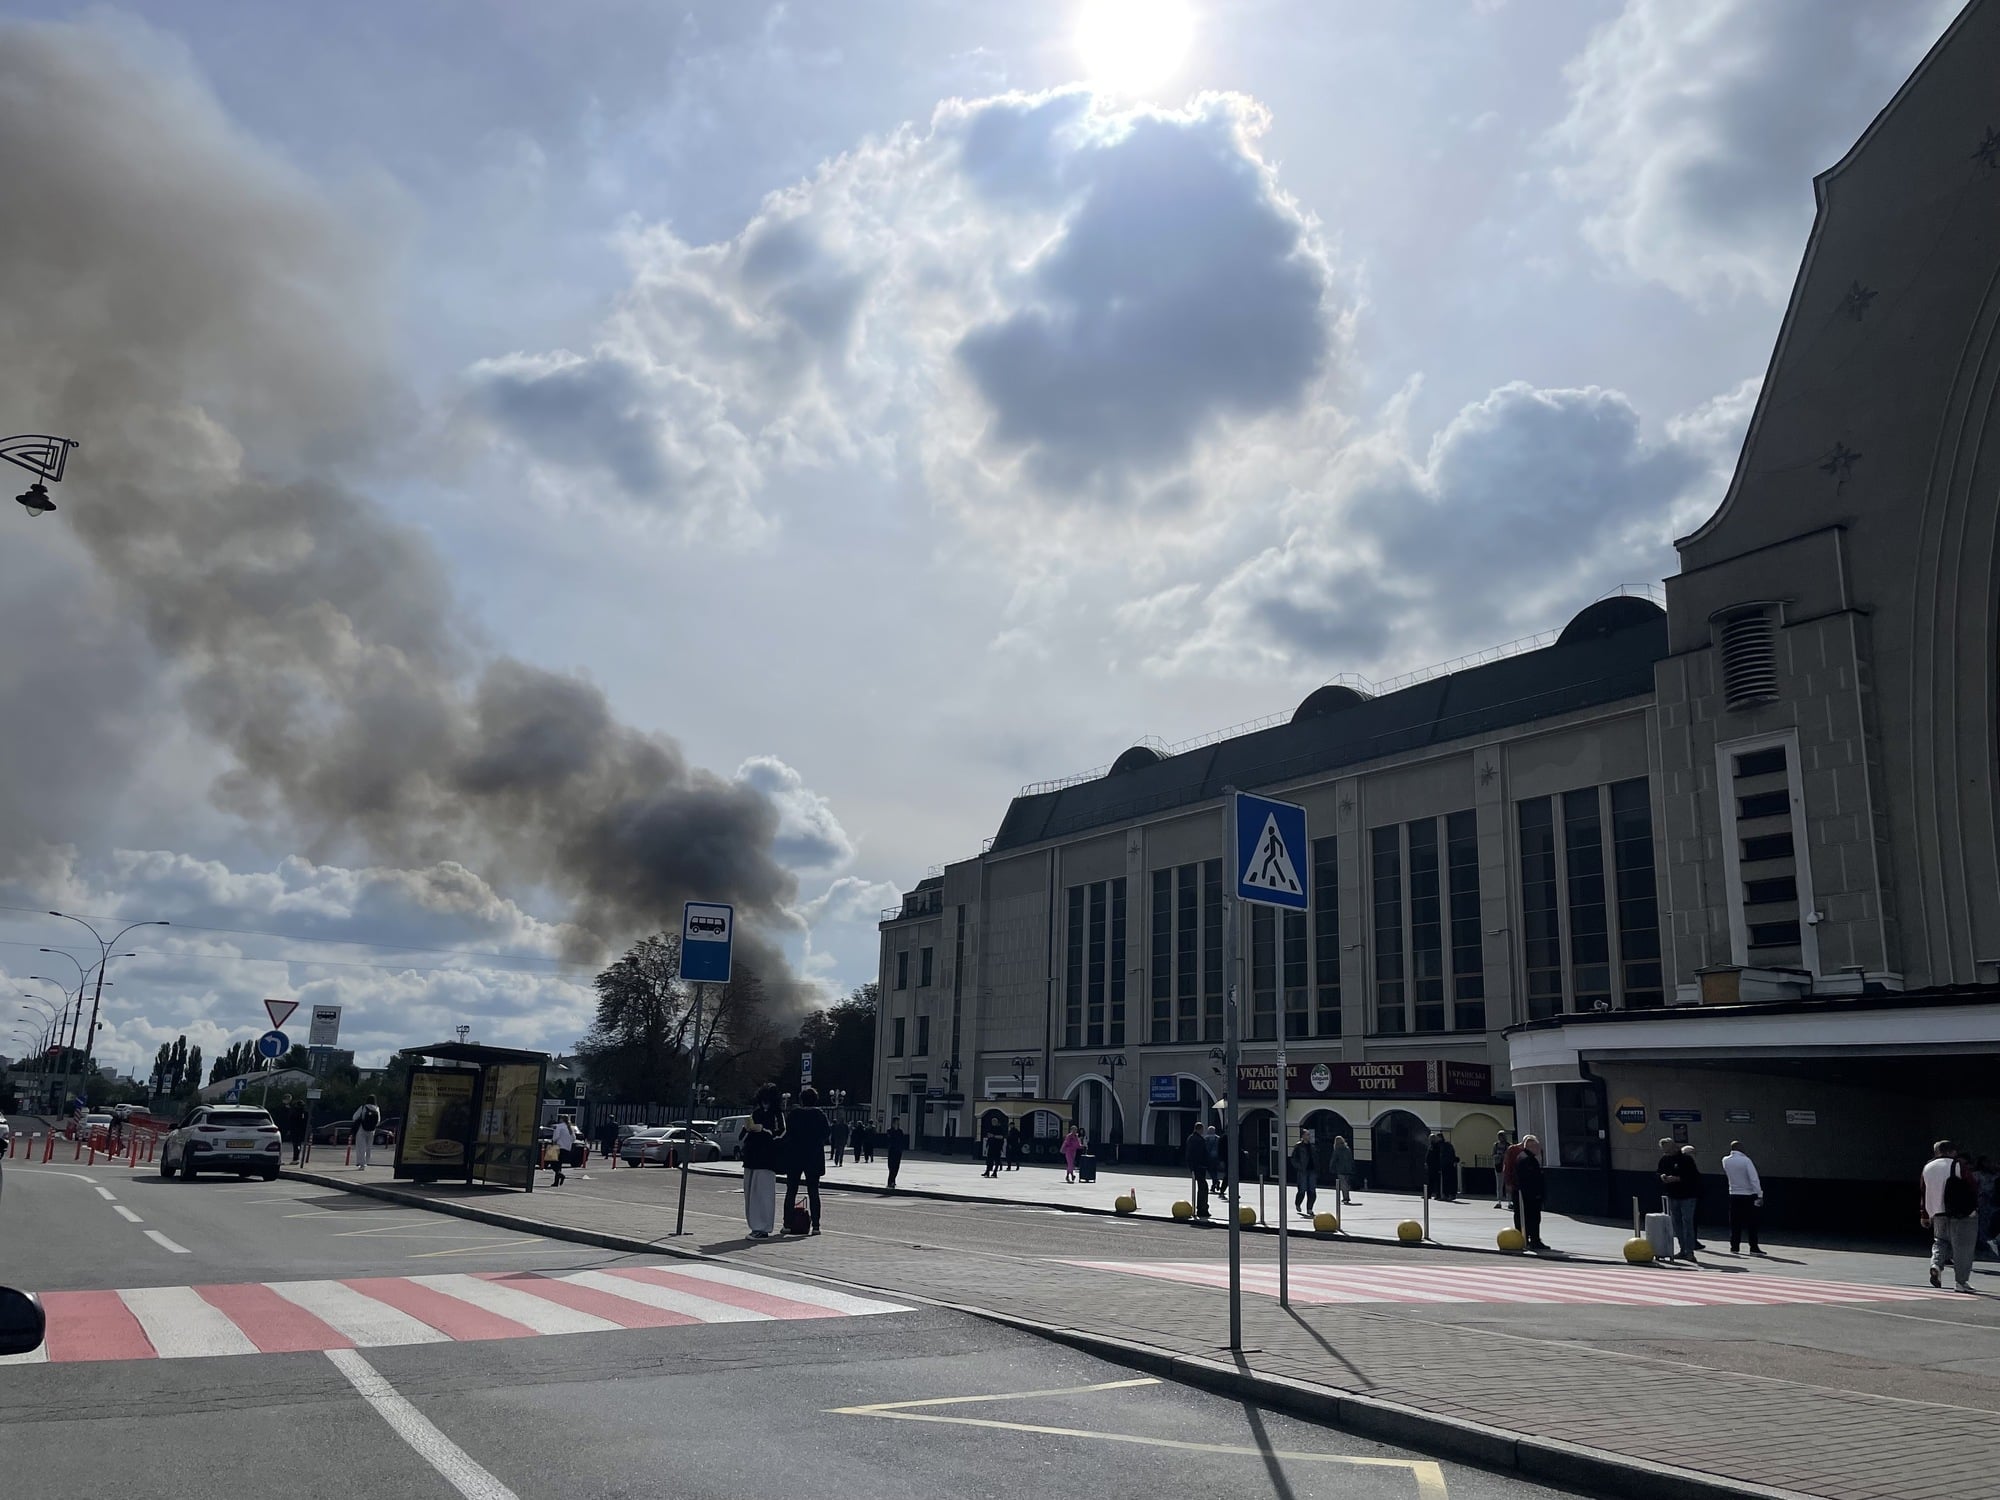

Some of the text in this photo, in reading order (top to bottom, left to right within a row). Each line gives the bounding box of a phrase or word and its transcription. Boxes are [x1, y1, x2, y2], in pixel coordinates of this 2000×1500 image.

[1240, 1065, 1298, 1080] УКРАЇНСКІ
[1350, 1063, 1404, 1077] КИЇВСЬКІ
[1357, 1078, 1397, 1090] ТОРТИ
